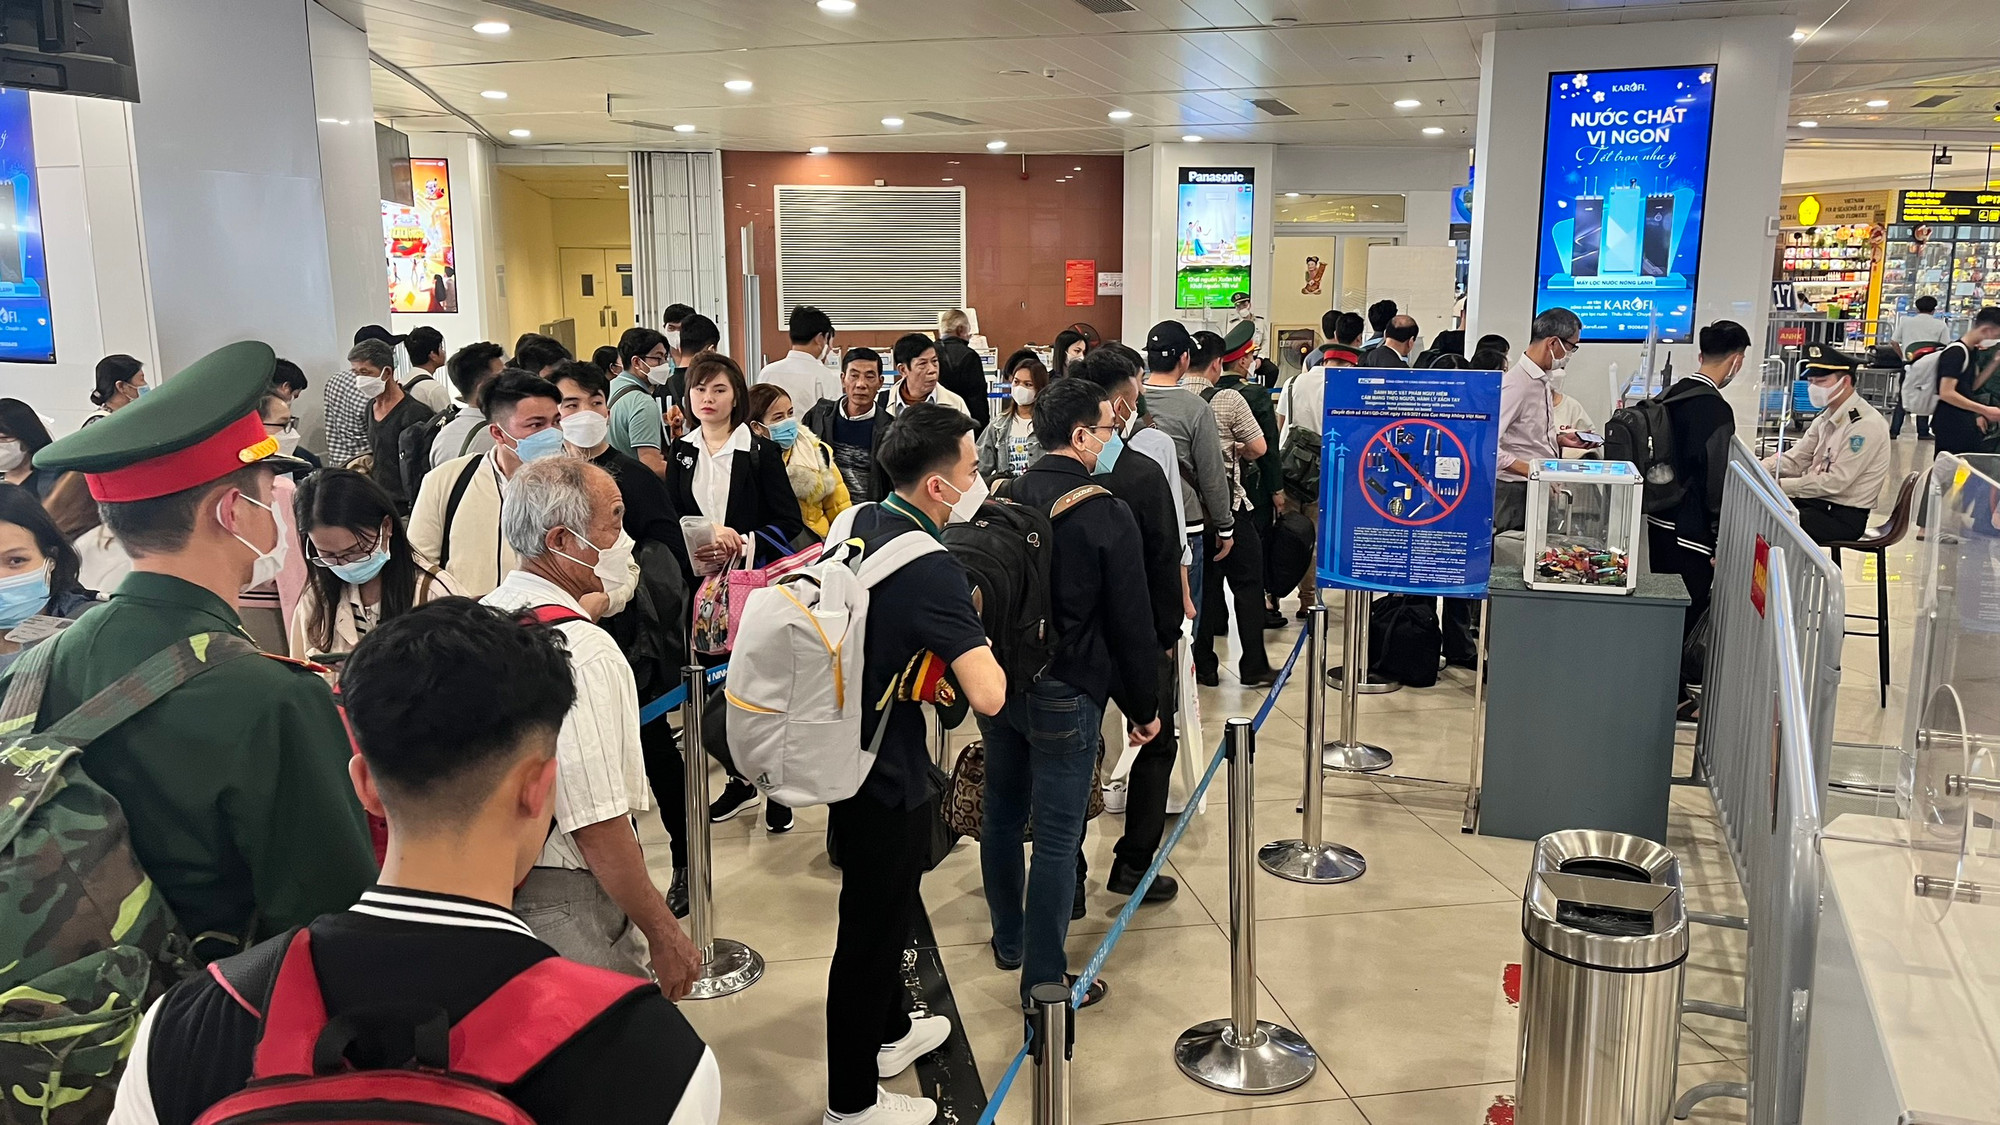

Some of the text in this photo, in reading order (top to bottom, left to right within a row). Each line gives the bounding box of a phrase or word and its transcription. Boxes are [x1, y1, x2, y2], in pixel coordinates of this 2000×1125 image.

[1612, 82, 1645, 92] KAROFI
[1571, 105, 1688, 127] NƯỚC CHẤT
[1587, 128, 1670, 149] VỊ NGON
[1188, 171, 1244, 182] Panasonic
[1604, 297, 1653, 311] KAROFI
[1774, 284, 1791, 307] 17
